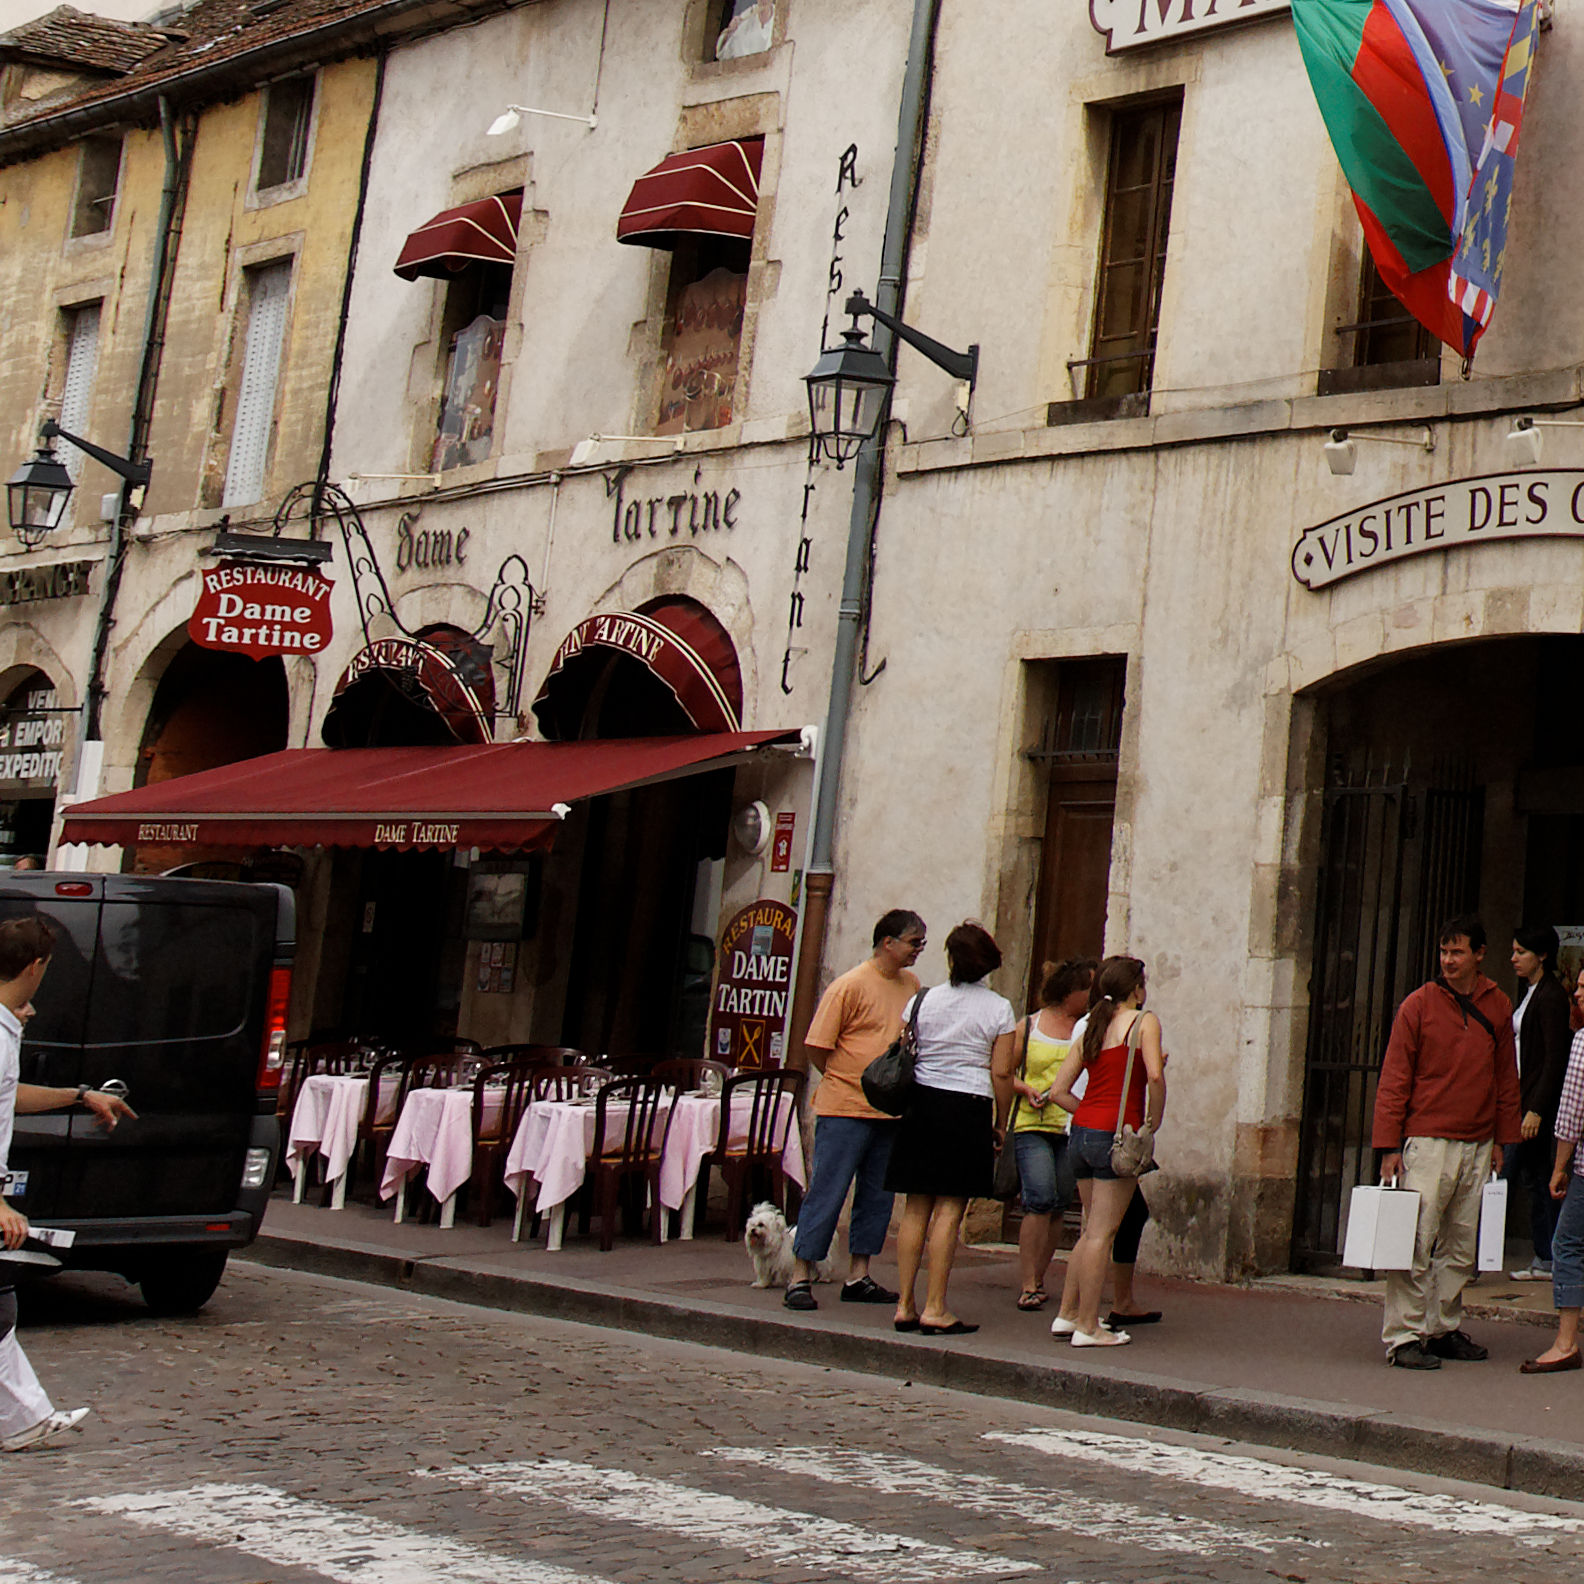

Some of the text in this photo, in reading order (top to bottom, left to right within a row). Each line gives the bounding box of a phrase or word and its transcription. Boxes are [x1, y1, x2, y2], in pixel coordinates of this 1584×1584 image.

[1316, 495, 1445, 571] VISITE
[1467, 482, 1549, 532] DES
[205, 567, 331, 602] RESTAURANT
[217, 593, 312, 624] Dame
[202, 617, 321, 650] Tartine
[27, 688, 61, 715] VEN
[138, 821, 460, 844] RESTAURANT DAME TARTINE
[732, 950, 789, 983] DAME
[718, 984, 789, 1018] TARTIN
